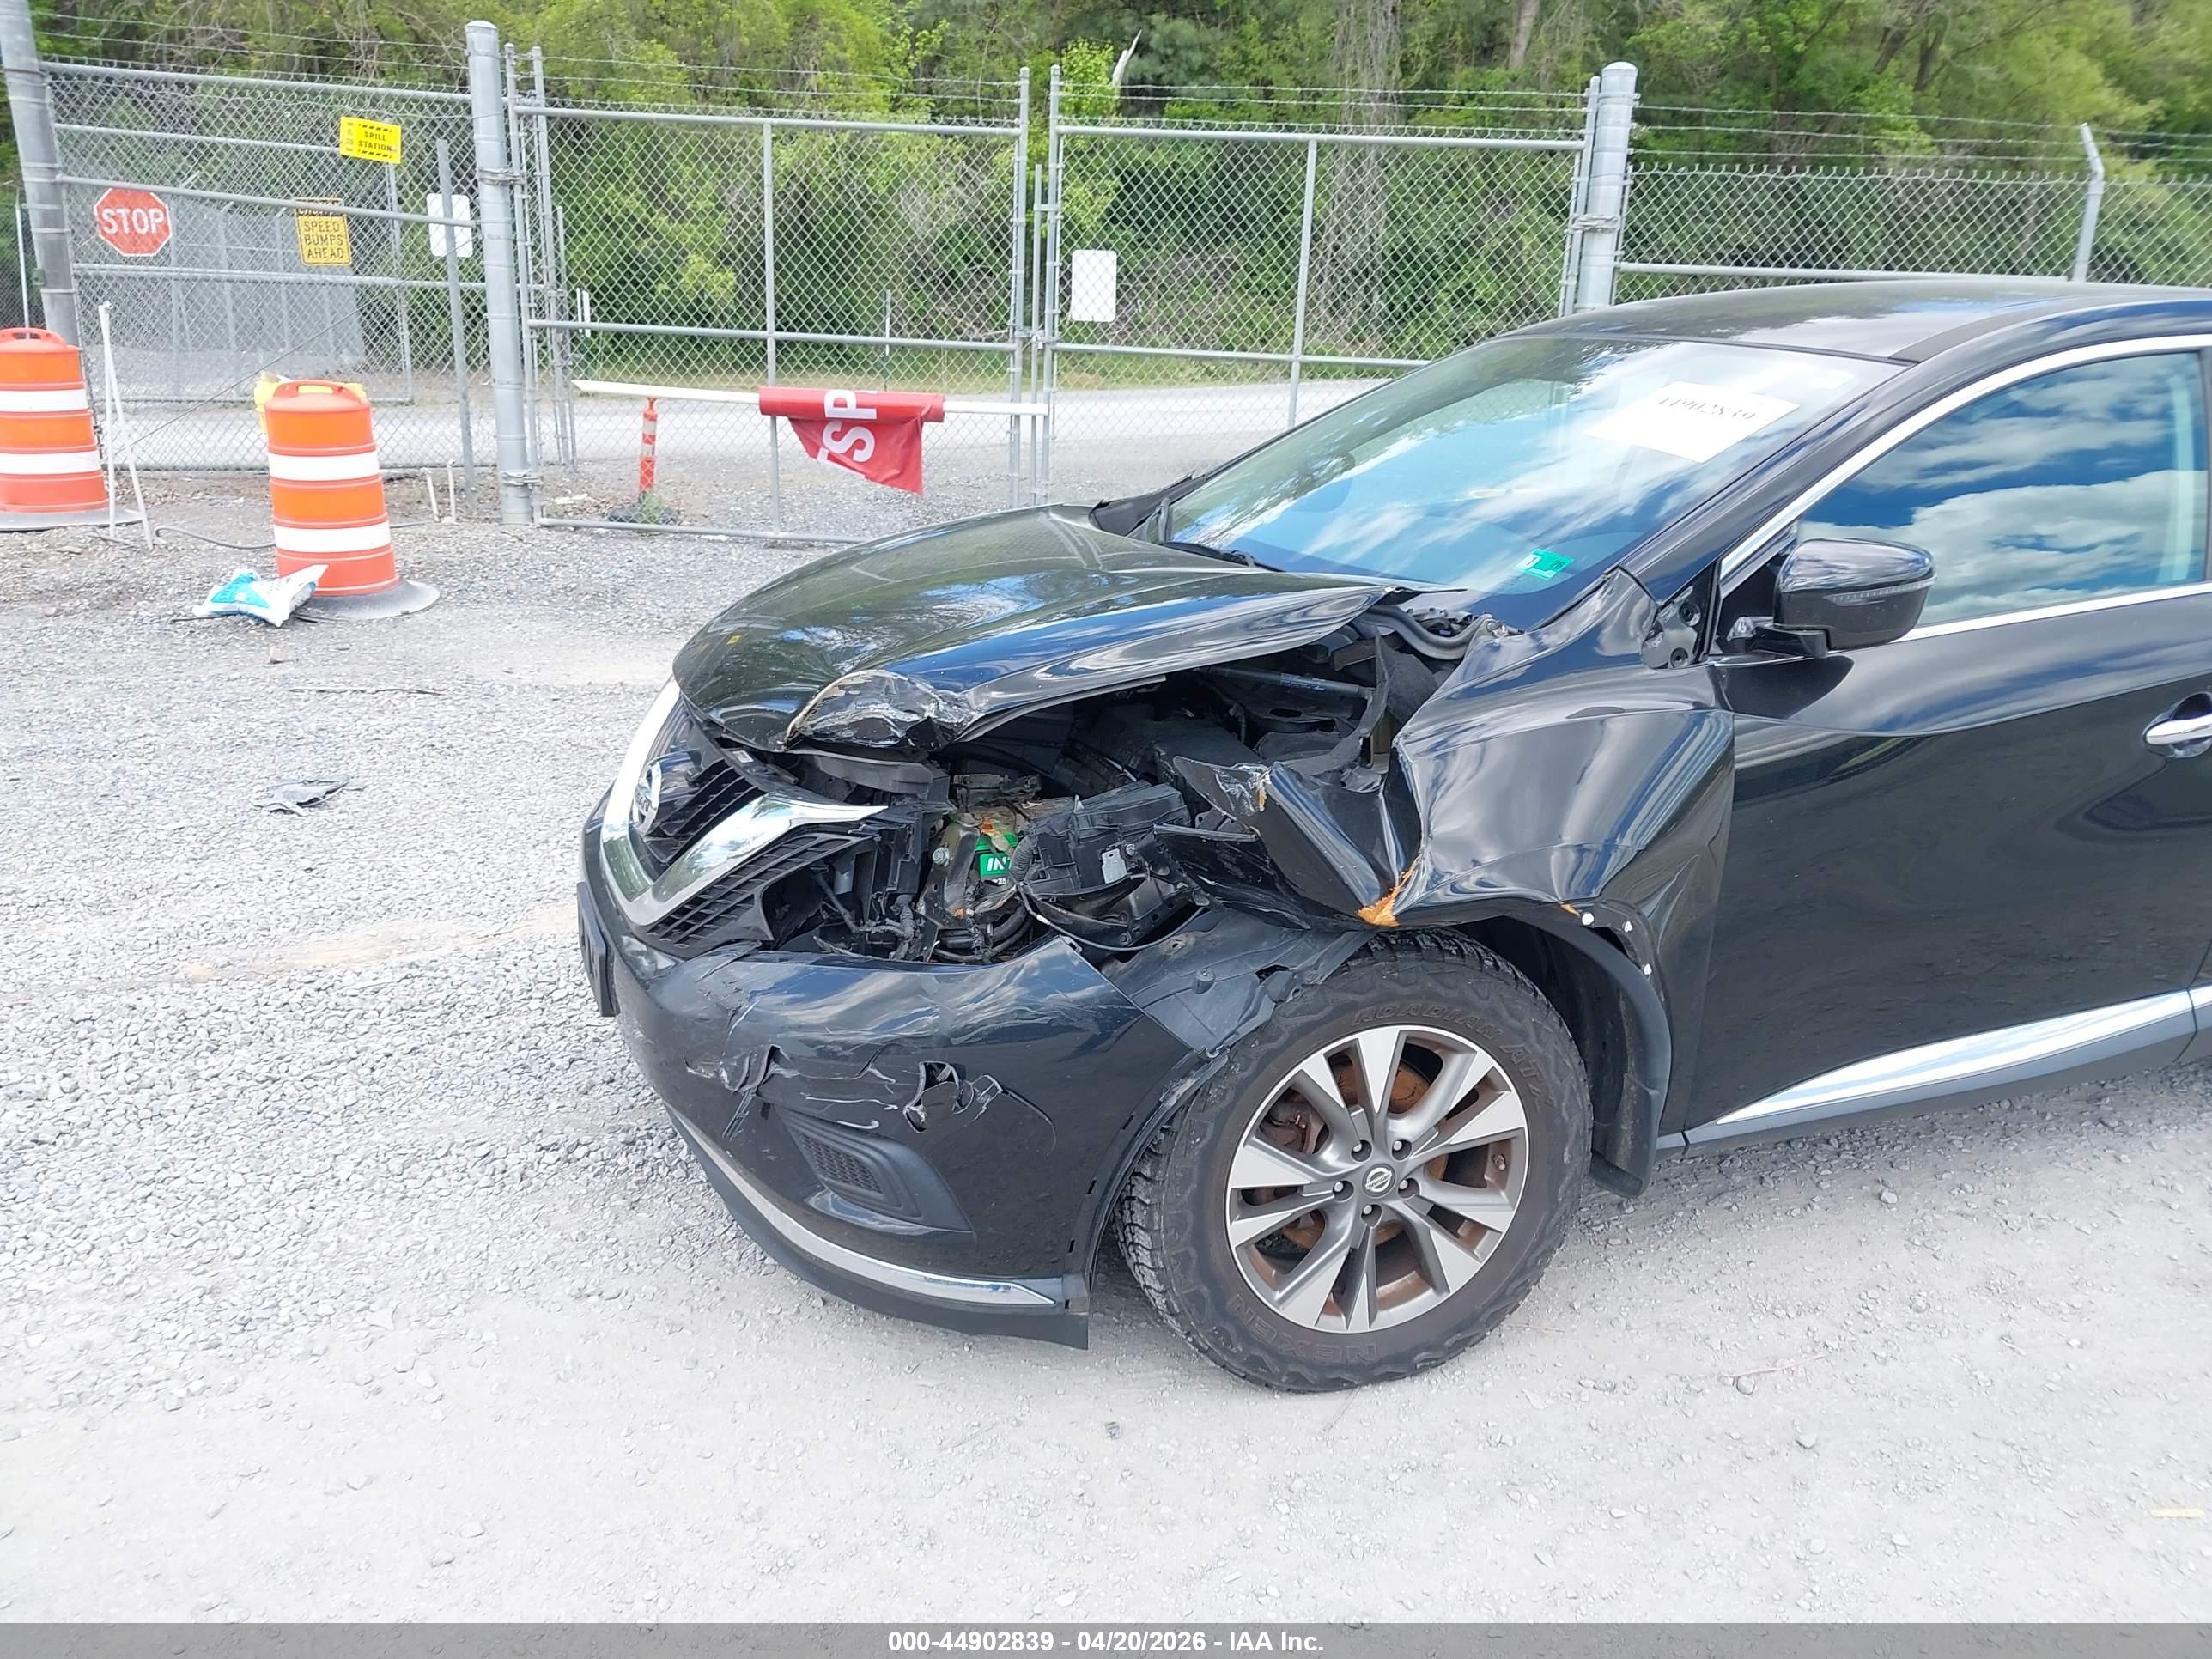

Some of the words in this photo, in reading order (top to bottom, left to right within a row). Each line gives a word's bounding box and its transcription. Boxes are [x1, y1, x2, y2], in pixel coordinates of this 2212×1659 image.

[364, 131, 387, 142] SPILL
[358, 140, 392, 152] STATION
[101, 208, 165, 234] STOP
[303, 221, 340, 232] SPEED
[305, 234, 343, 246] BUMPS
[307, 247, 344, 259] AHEAD
[1352, 1003, 1504, 1041] ROADIAN
[1226, 1292, 1387, 1363] NEXEN
